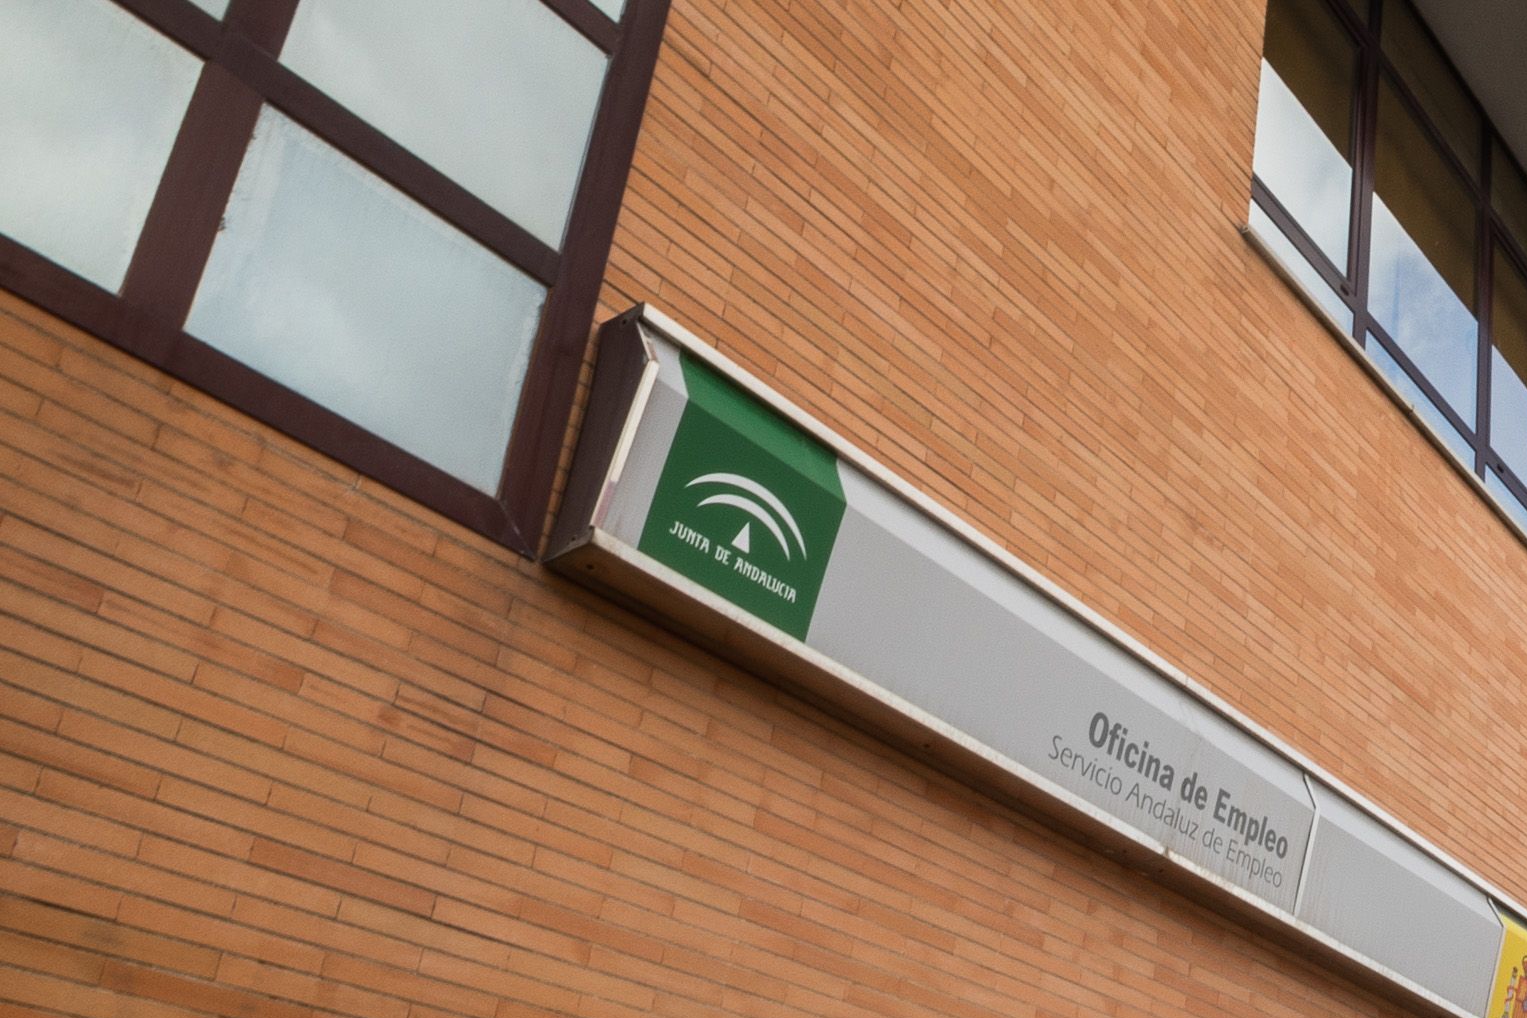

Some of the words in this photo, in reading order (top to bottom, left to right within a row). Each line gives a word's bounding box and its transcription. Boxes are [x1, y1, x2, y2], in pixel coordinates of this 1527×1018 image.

[669, 521, 710, 554] JUNTA
[714, 544, 732, 566] DE
[733, 556, 797, 604] ANDALUCIA
[1048, 734, 1123, 796] Servicio
[1125, 782, 1200, 842] Andaluz
[1201, 827, 1223, 854] de
[1226, 838, 1283, 889] Empleo
[1088, 711, 1175, 792] Oficina
[1180, 772, 1209, 811] de
[1213, 788, 1289, 860] Empleo
